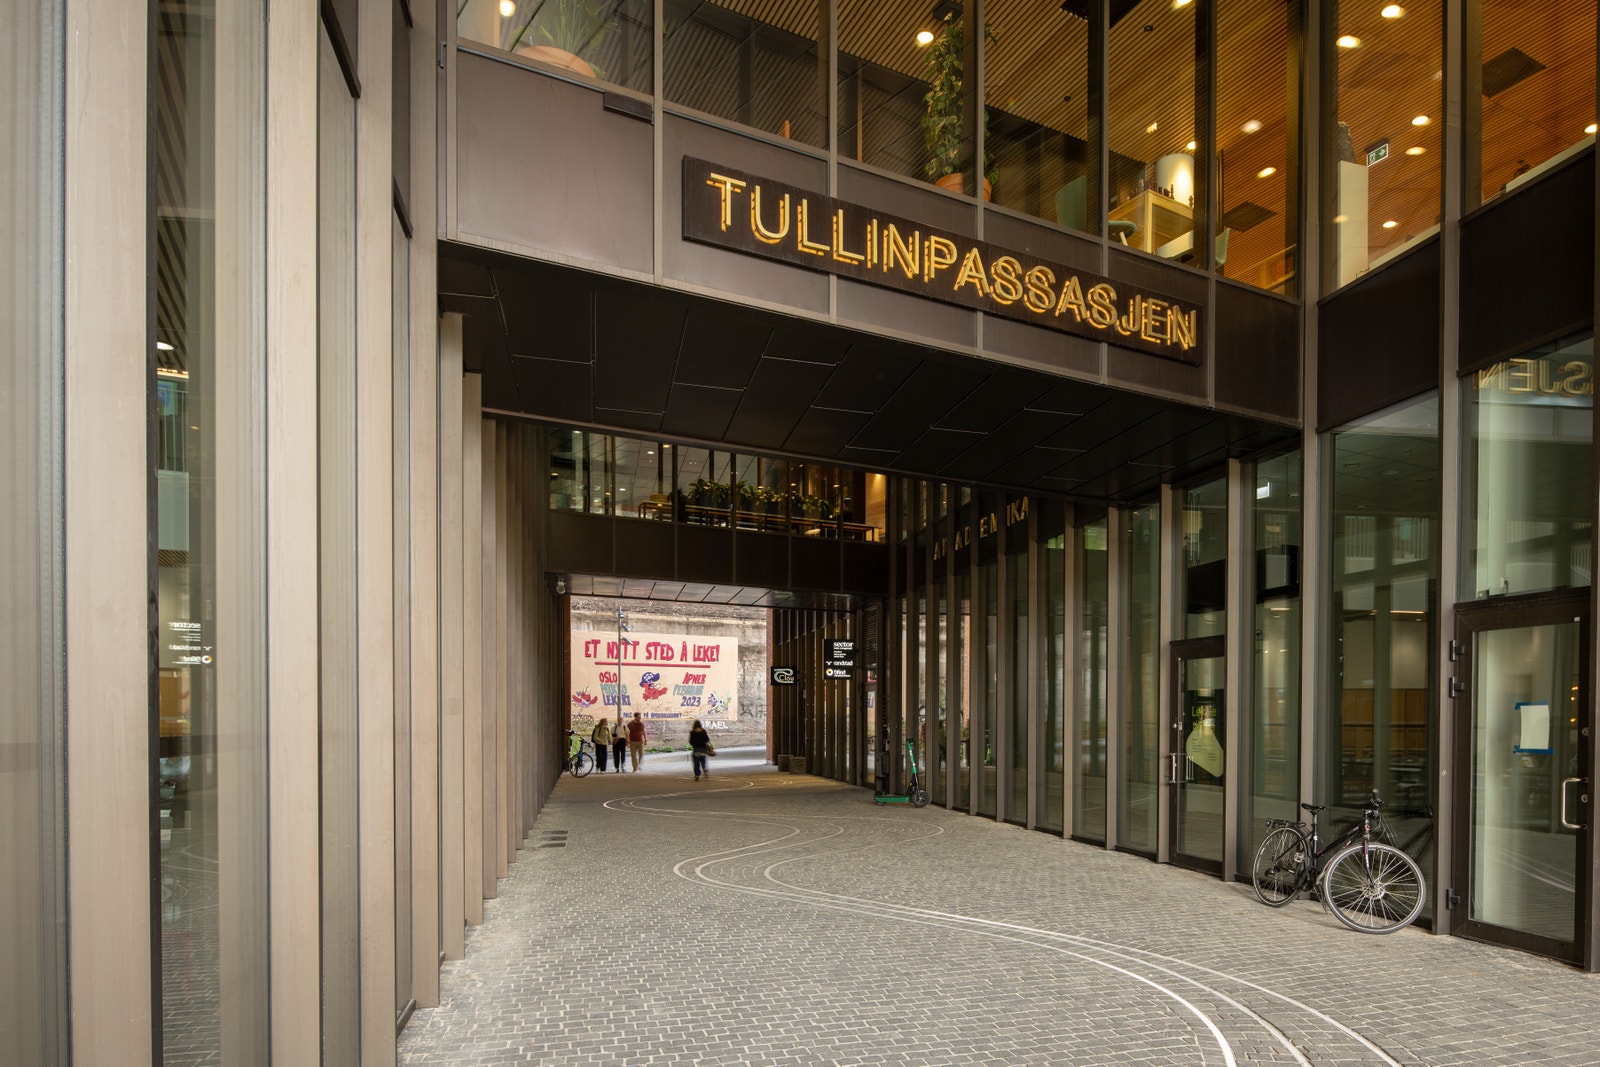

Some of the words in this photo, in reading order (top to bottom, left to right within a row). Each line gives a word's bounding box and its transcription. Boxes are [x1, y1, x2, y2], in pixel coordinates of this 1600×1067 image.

[705, 172, 1198, 351] TULLINPASSASJEN
[584, 639, 601, 658] ET
[646, 641, 675, 661] STED
[693, 644, 720, 662] LEKE!
[598, 671, 618, 683] OSLO
[603, 694, 631, 706] LEKRI
[680, 696, 702, 707] 2023
